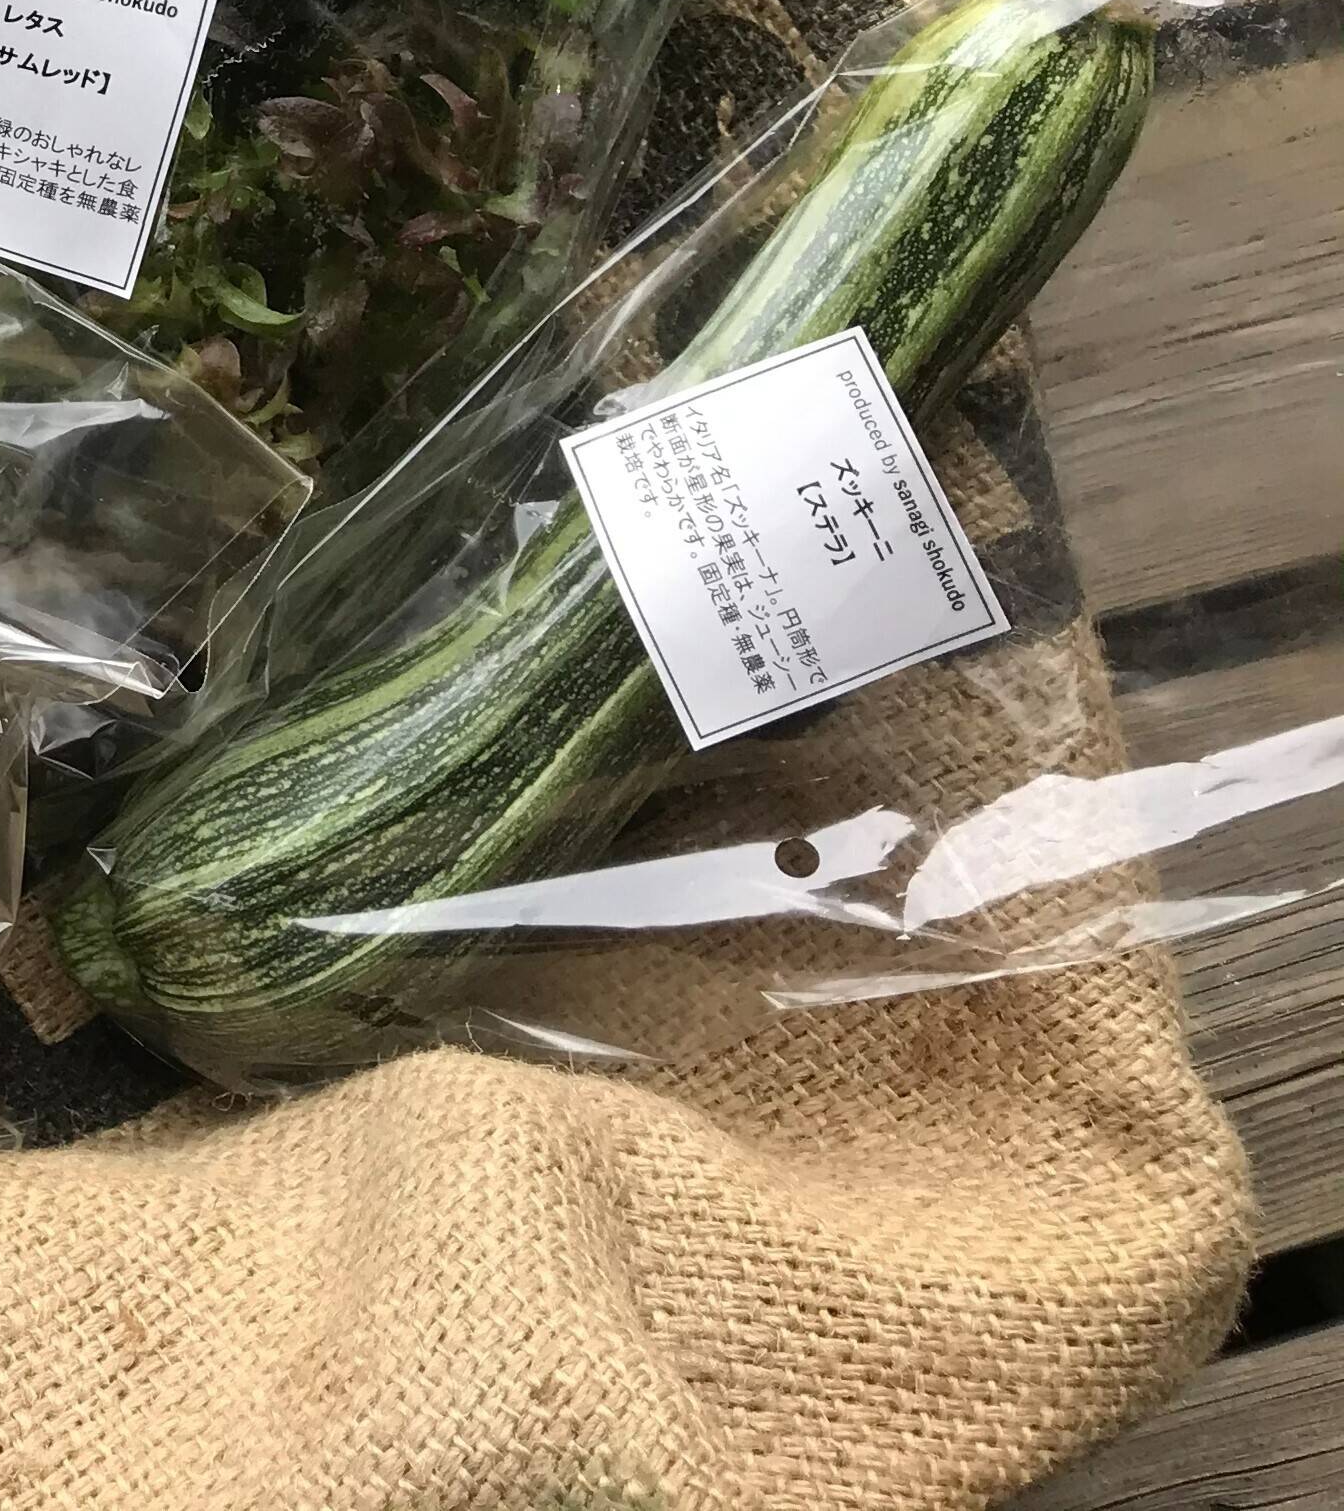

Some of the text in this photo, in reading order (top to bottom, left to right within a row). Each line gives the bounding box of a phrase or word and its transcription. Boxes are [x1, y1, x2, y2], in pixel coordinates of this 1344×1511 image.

[3, 3, 64, 38] レタス
[615, 432, 658, 518] 栽培です。
[829, 457, 894, 562] ズッキーニ
[835, 369, 966, 612] produced by sanagi shokudo
[795, 479, 856, 566] 【ステラ】
